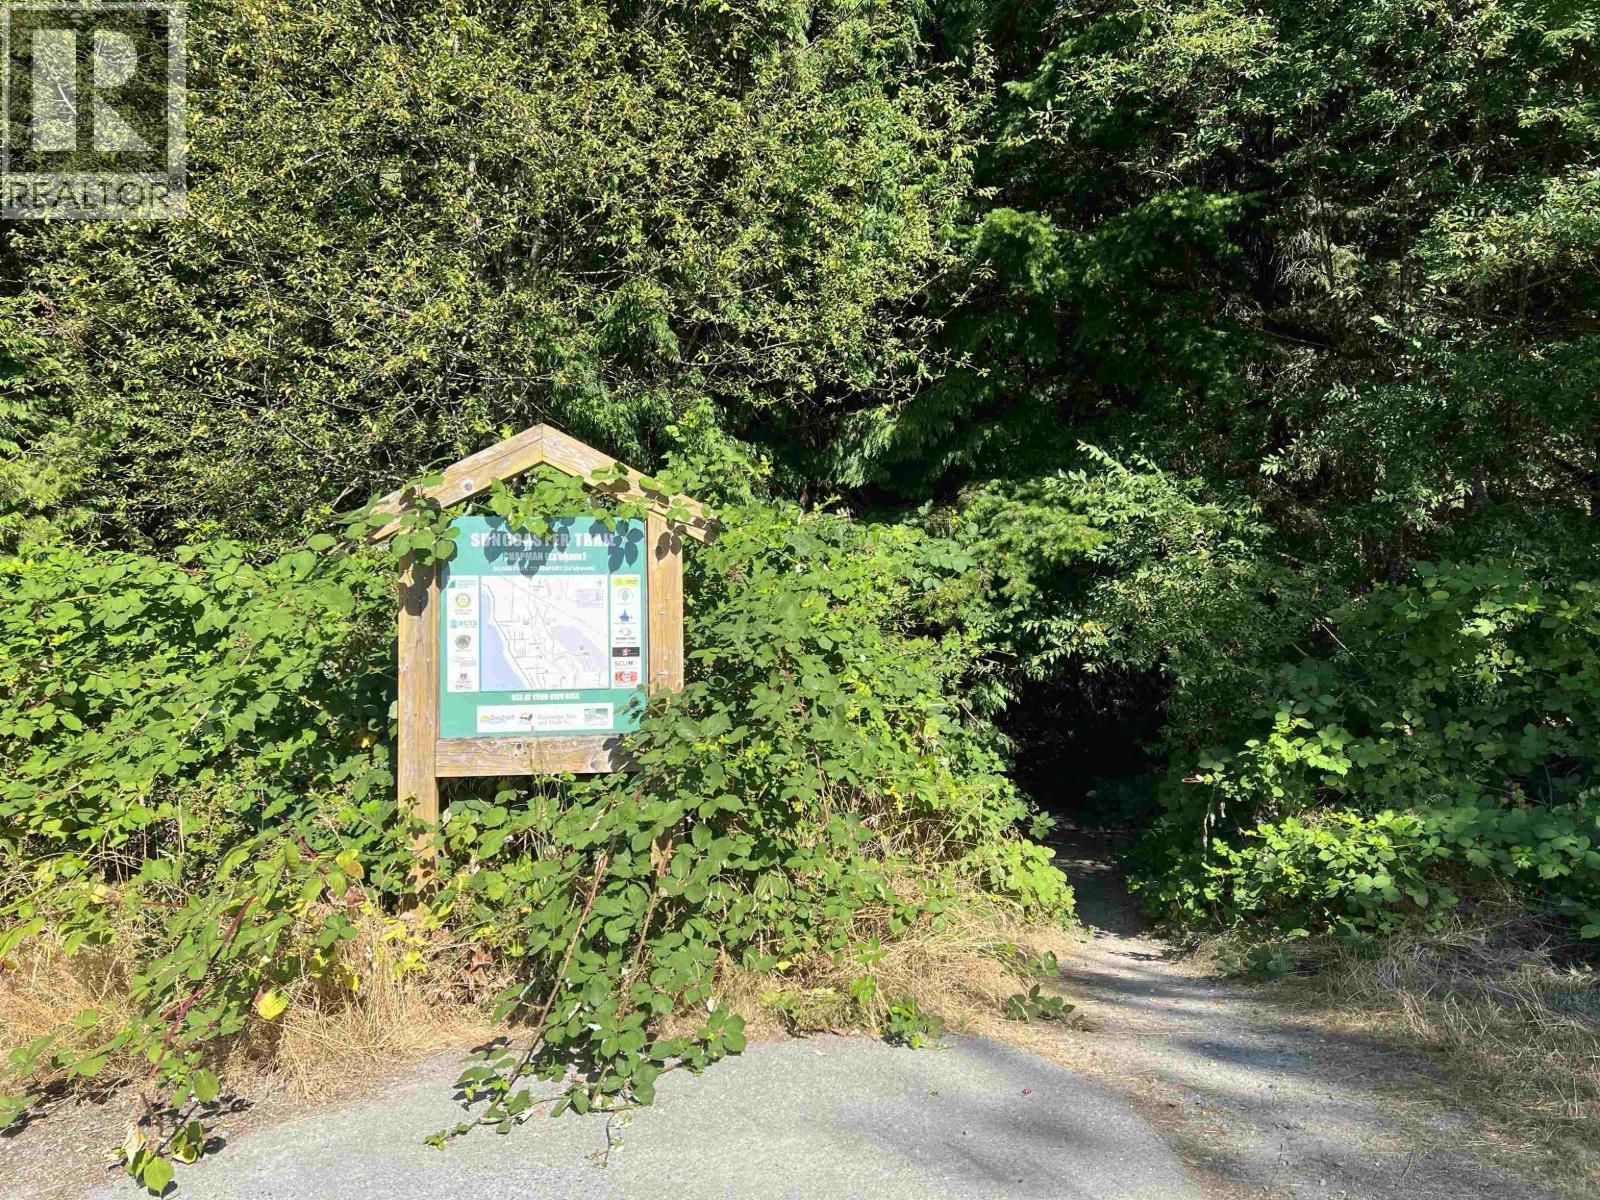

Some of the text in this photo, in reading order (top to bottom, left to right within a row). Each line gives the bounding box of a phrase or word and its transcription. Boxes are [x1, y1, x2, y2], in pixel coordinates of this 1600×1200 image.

[470, 532, 616, 547] SUNCOASTER TRAIL
[503, 551, 543, 561] CHAPMAN
